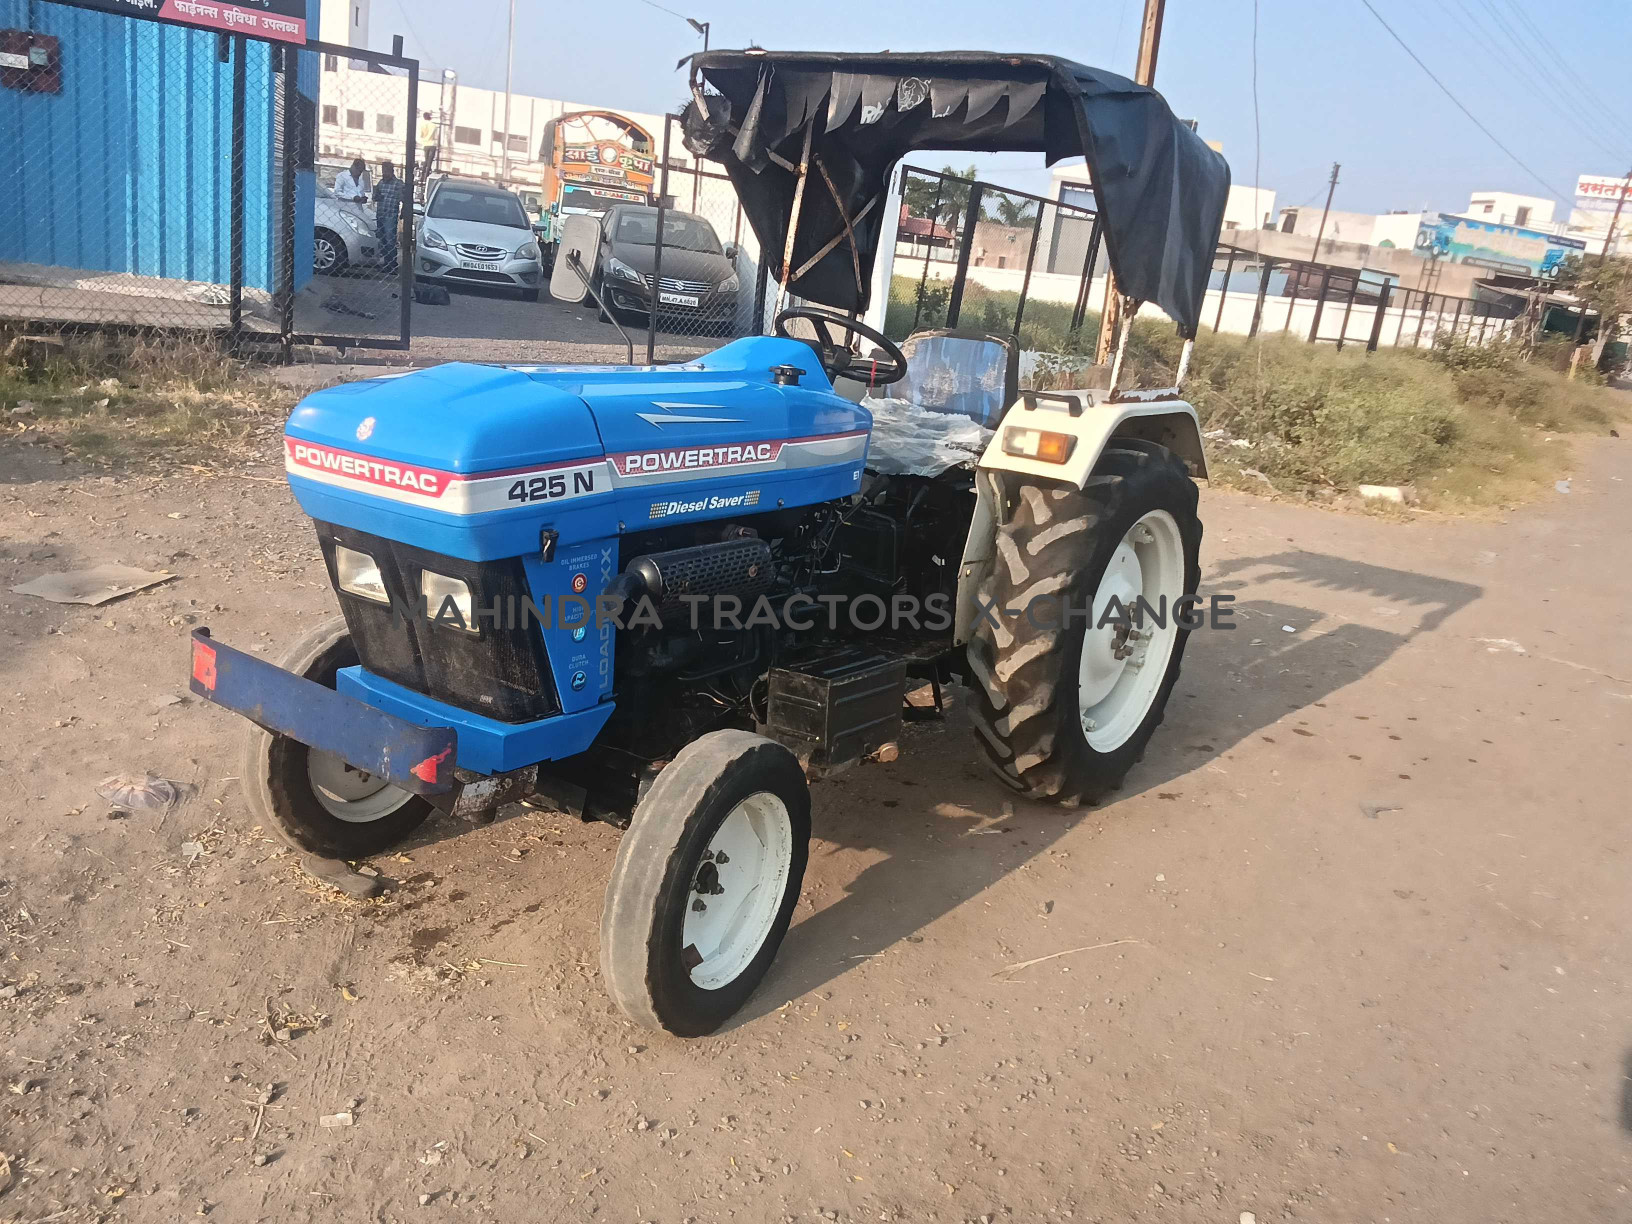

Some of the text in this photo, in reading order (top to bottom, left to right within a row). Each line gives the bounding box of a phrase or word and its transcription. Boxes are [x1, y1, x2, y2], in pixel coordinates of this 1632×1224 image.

[223, 7, 257, 27] सुविधा
[261, 16, 299, 35] उपलब्ध
[625, 443, 771, 473] POWERTRAC
[295, 444, 438, 493] POWERTRAC
[508, 470, 594, 502] 425 N
[666, 495, 744, 515] Diesel Saver
[569, 562, 590, 571] BRAKES
[570, 553, 598, 564] IMMERSED
[568, 660, 589, 670] CLUTCH
[571, 654, 586, 662] DURA
